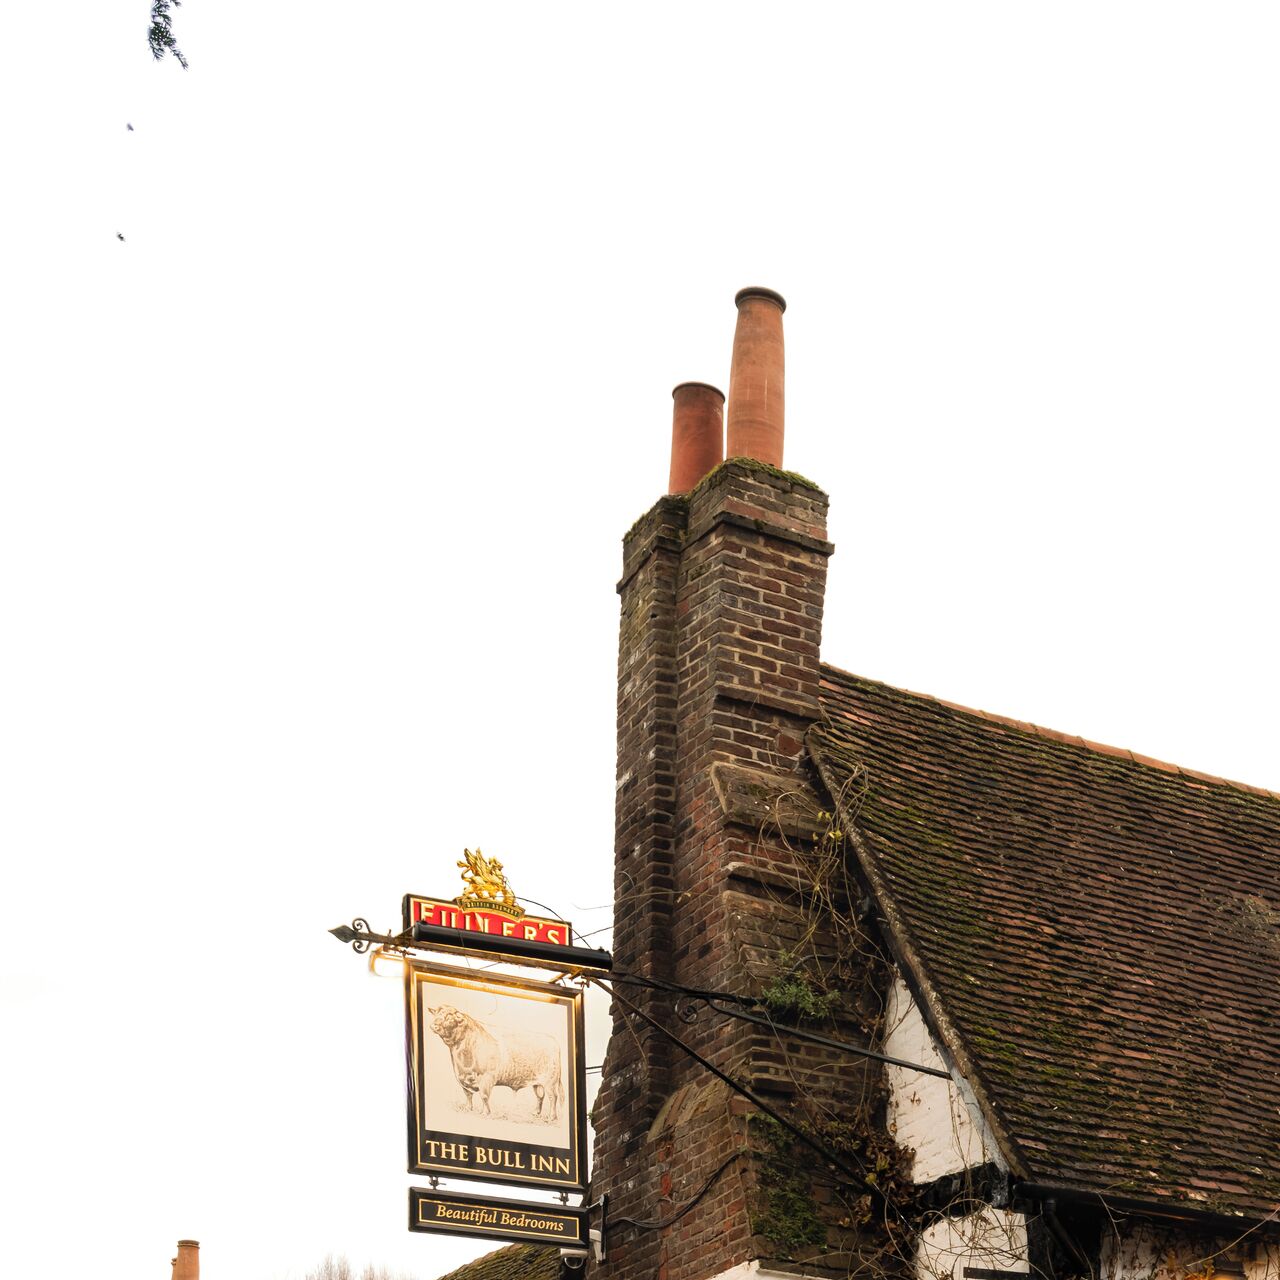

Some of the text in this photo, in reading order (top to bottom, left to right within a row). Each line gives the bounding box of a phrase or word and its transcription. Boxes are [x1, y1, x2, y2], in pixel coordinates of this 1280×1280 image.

[425, 1139, 571, 1175] THE BULL INN
[436, 1204, 564, 1232] Beautiful Bedrooms
